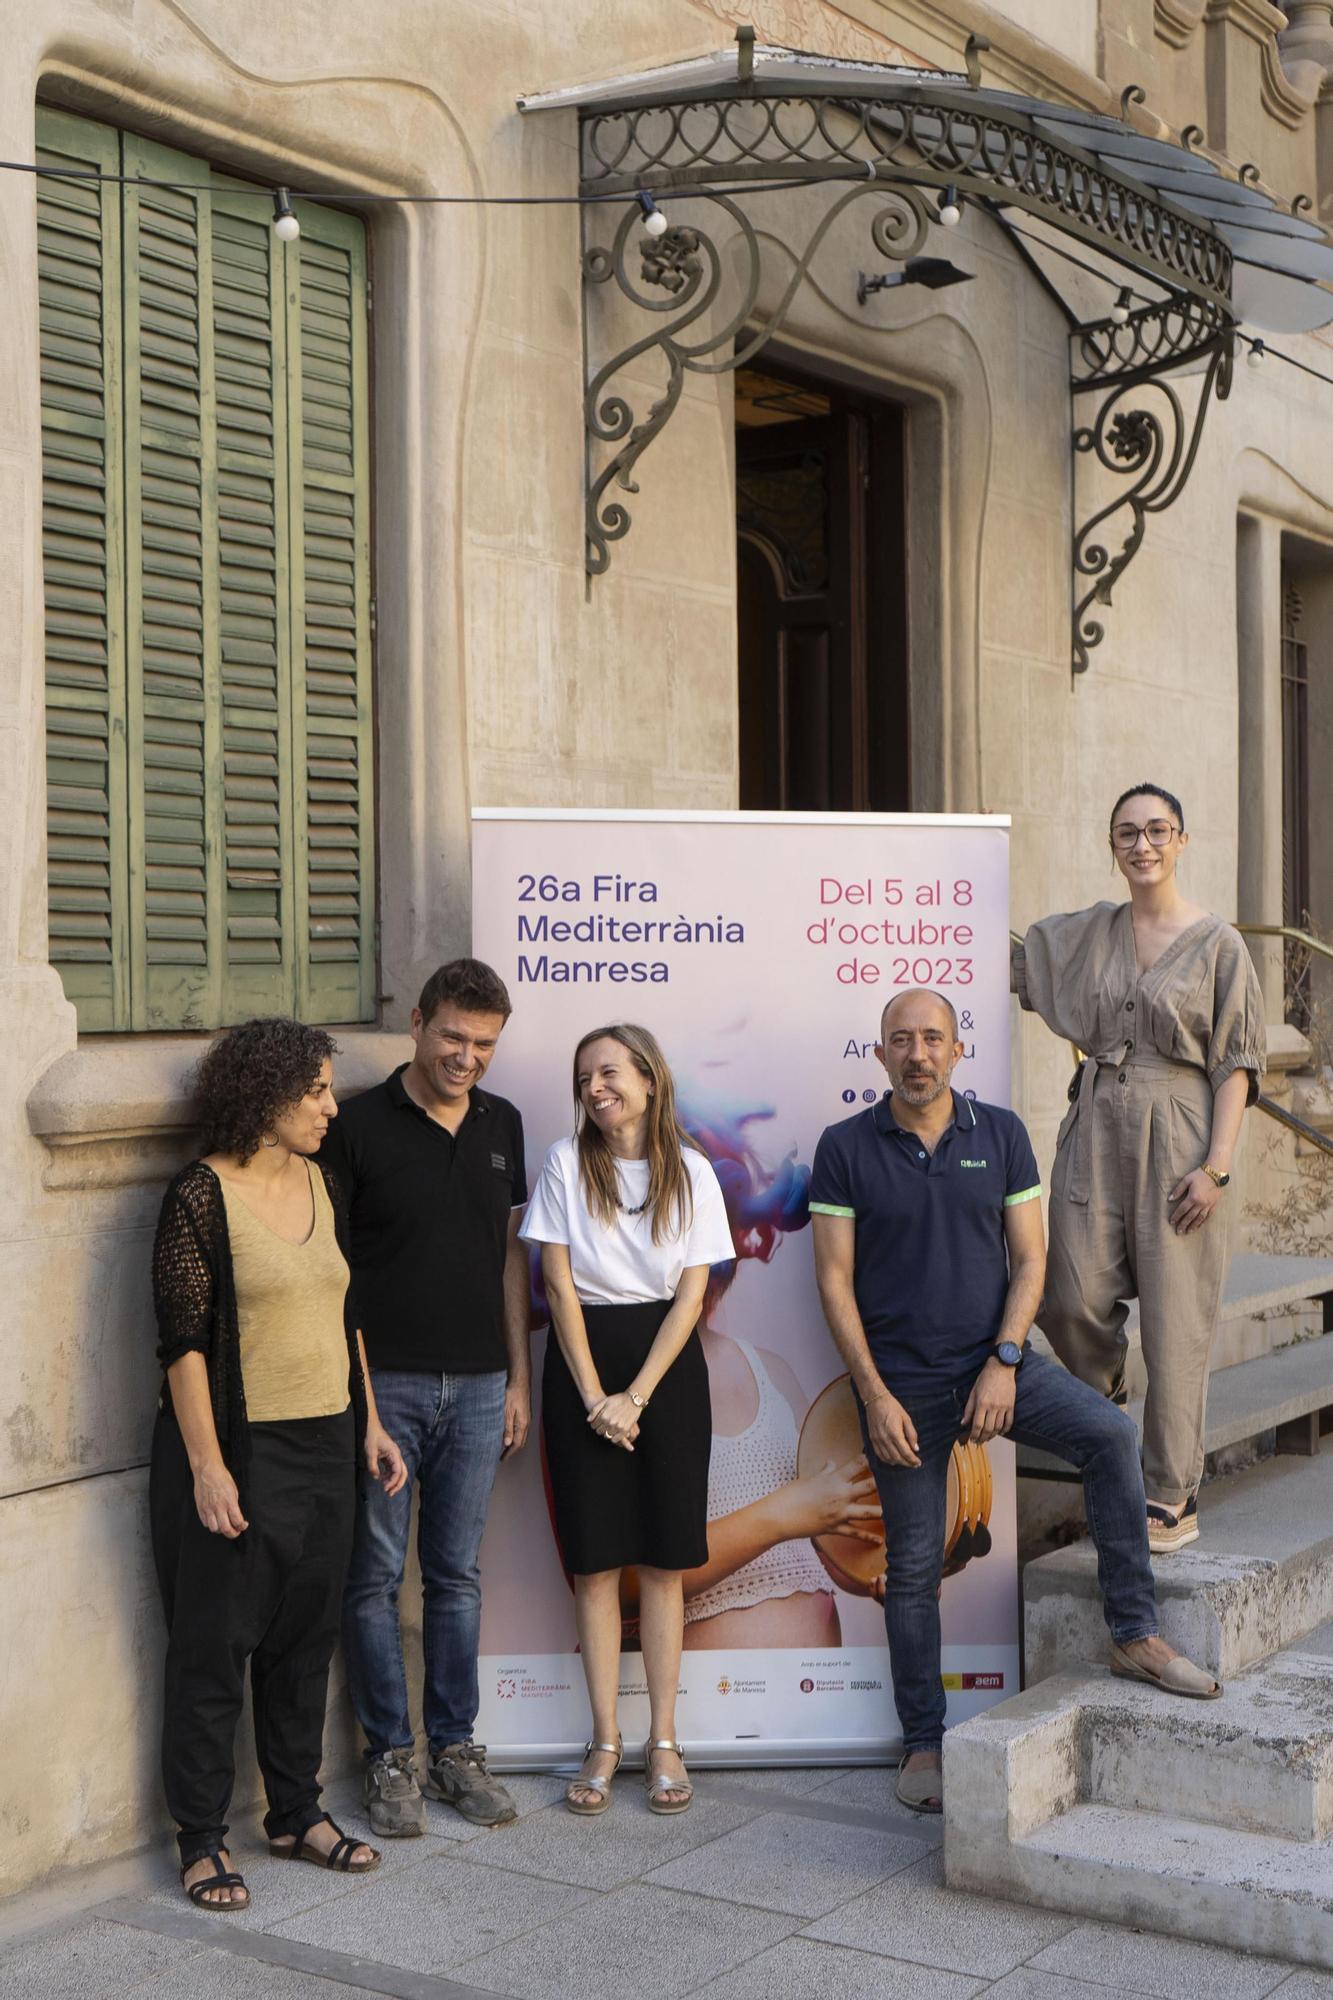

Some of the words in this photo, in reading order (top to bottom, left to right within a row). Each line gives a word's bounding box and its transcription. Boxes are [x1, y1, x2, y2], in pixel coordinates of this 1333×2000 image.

[517, 874, 581, 902] 26a
[593, 873, 658, 902] Fira
[820, 878, 872, 905] Del
[884, 879, 904, 905] 5
[915, 879, 941, 906] al
[952, 880, 973, 906] 8
[517, 913, 745, 944] Mediterrània
[517, 955, 669, 983] Manresa
[836, 957, 880, 985] de
[892, 957, 974, 985] 2023
[959, 1010, 975, 1030] &
